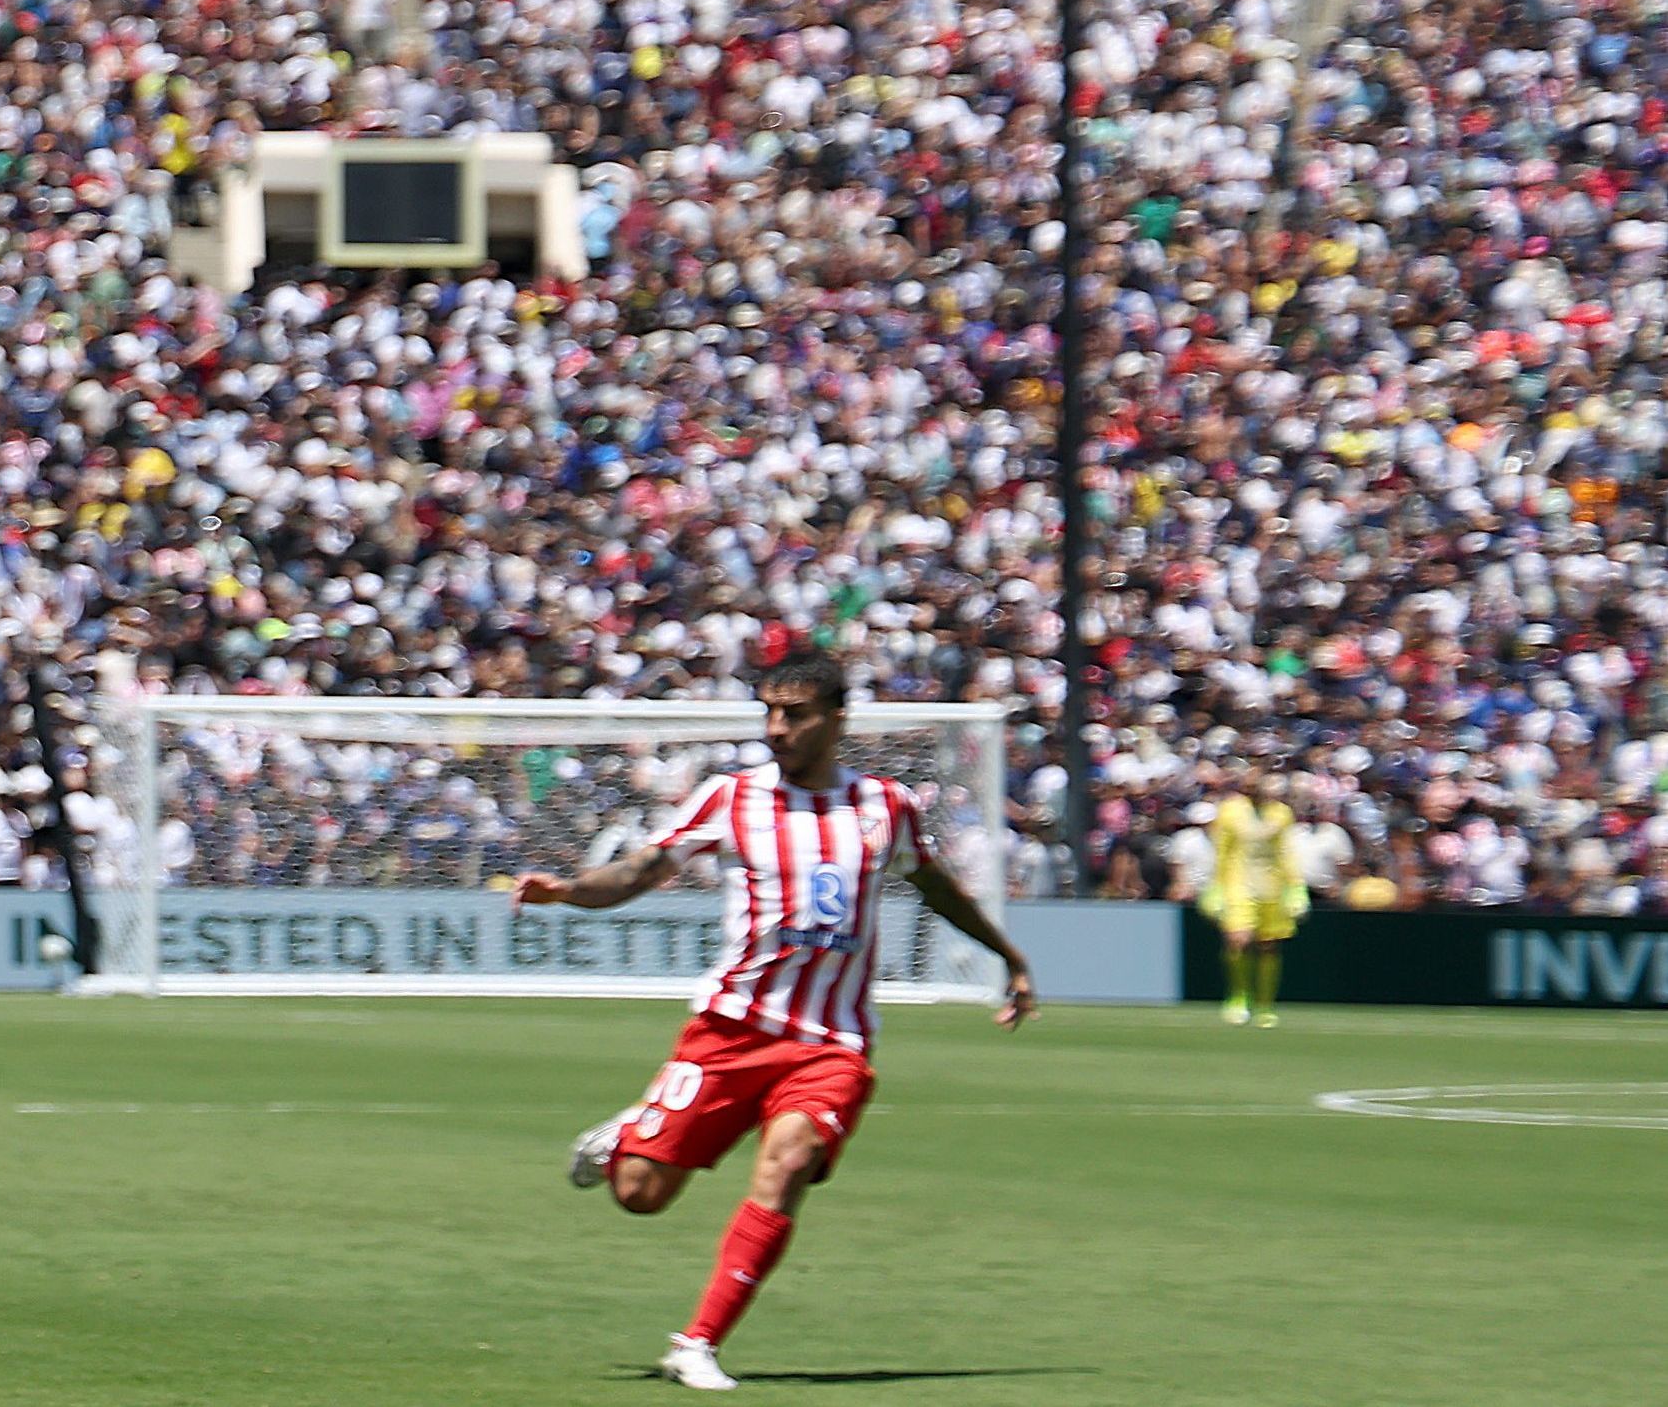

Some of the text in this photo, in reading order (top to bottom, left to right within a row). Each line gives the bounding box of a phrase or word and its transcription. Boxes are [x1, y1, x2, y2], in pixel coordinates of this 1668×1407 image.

[10, 913, 376, 970] IESTED
[409, 916, 474, 966] IN
[512, 916, 725, 969] BETTE
